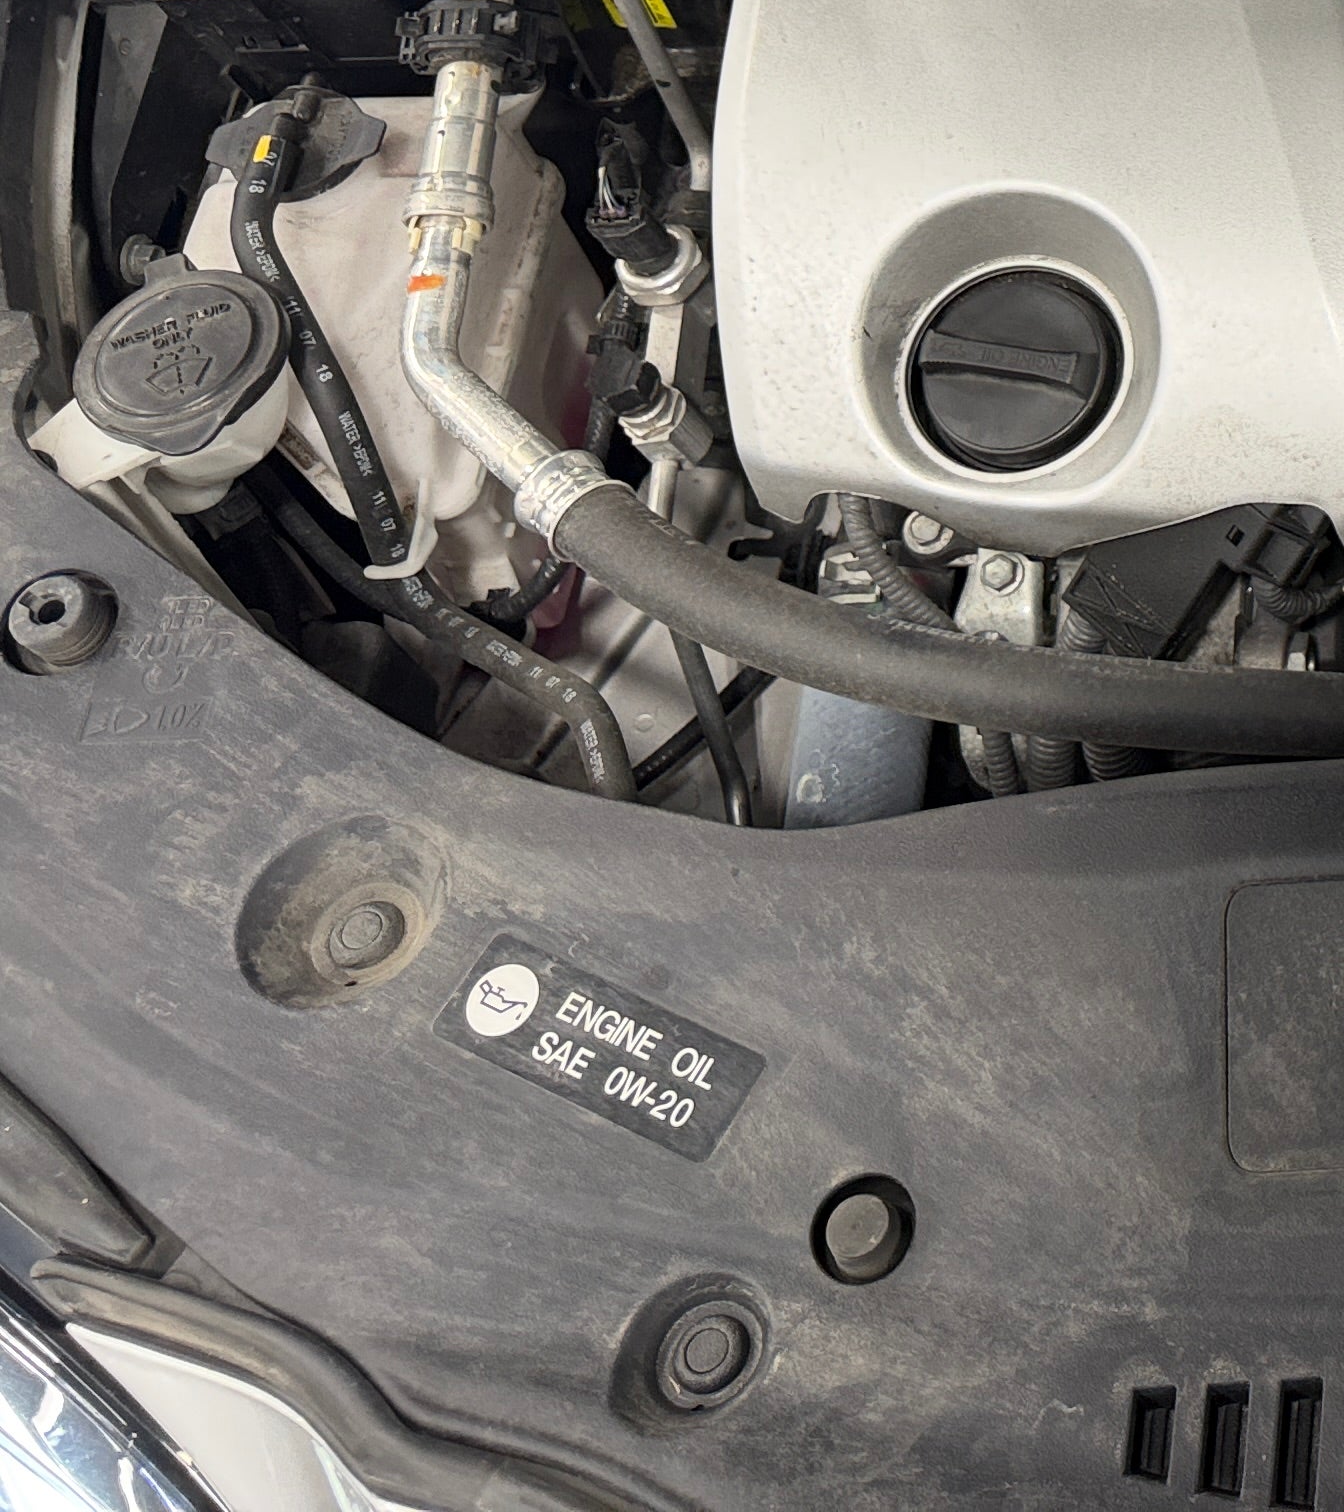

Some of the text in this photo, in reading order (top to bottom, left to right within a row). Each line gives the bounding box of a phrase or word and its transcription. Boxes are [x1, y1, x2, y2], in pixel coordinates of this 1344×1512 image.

[110, 303, 232, 350] WASHER FLUID
[152, 326, 194, 349] ONLY
[249, 179, 268, 194] 18
[300, 330, 317, 345] 07
[315, 363, 334, 383] 18
[338, 410, 361, 445] WATER
[380, 516, 397, 532] 07
[531, 1031, 695, 1128] SAE 0W-20
[555, 991, 715, 1091] ENGINE OIL
